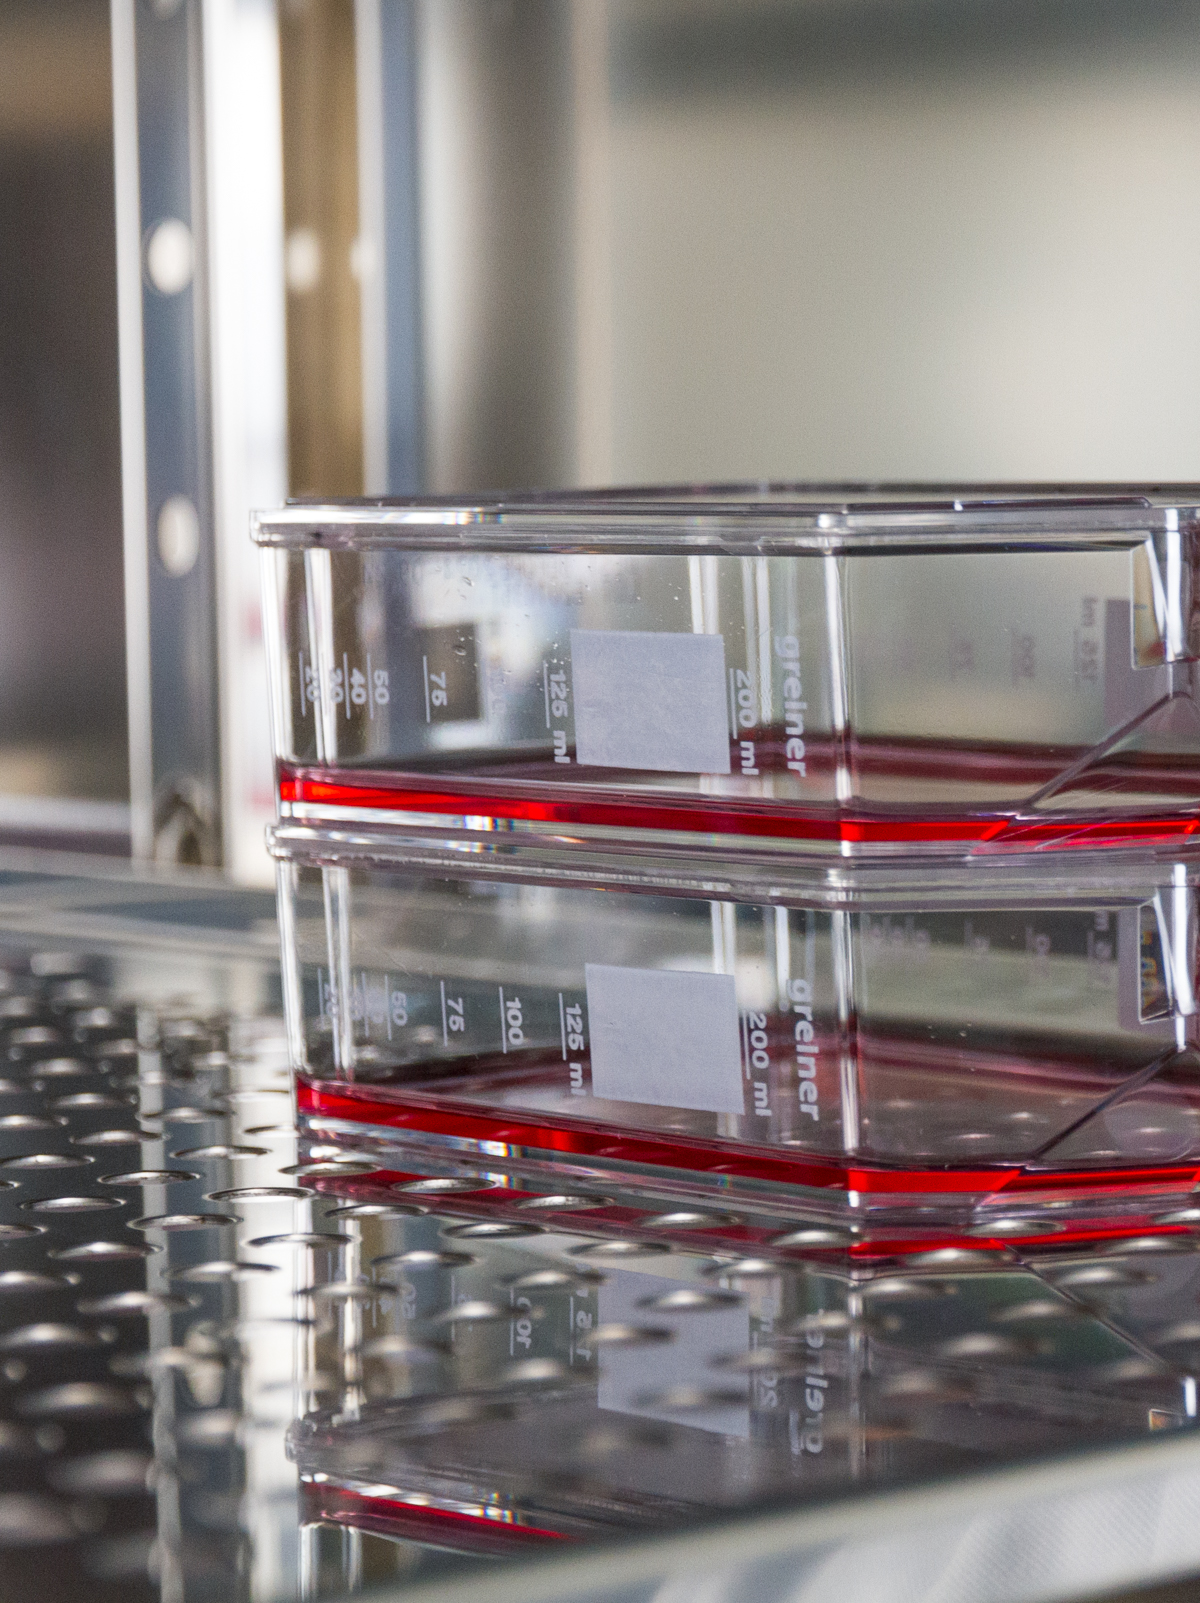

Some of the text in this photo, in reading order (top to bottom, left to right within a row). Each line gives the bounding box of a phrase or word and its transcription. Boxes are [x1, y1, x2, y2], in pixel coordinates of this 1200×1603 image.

[350, 667, 367, 705] 40
[373, 669, 390, 705] 50
[429, 671, 448, 707] 75
[549, 669, 571, 764] 125 ml
[774, 635, 808, 778] greiner
[736, 668, 759, 776] 200 ml
[390, 990, 409, 1027] 50
[447, 997, 465, 1032] 75
[505, 997, 524, 1046] 100
[565, 1003, 587, 1096] 125 ml
[749, 1011, 773, 1117] 200 ml
[786, 978, 820, 1122] greiner
